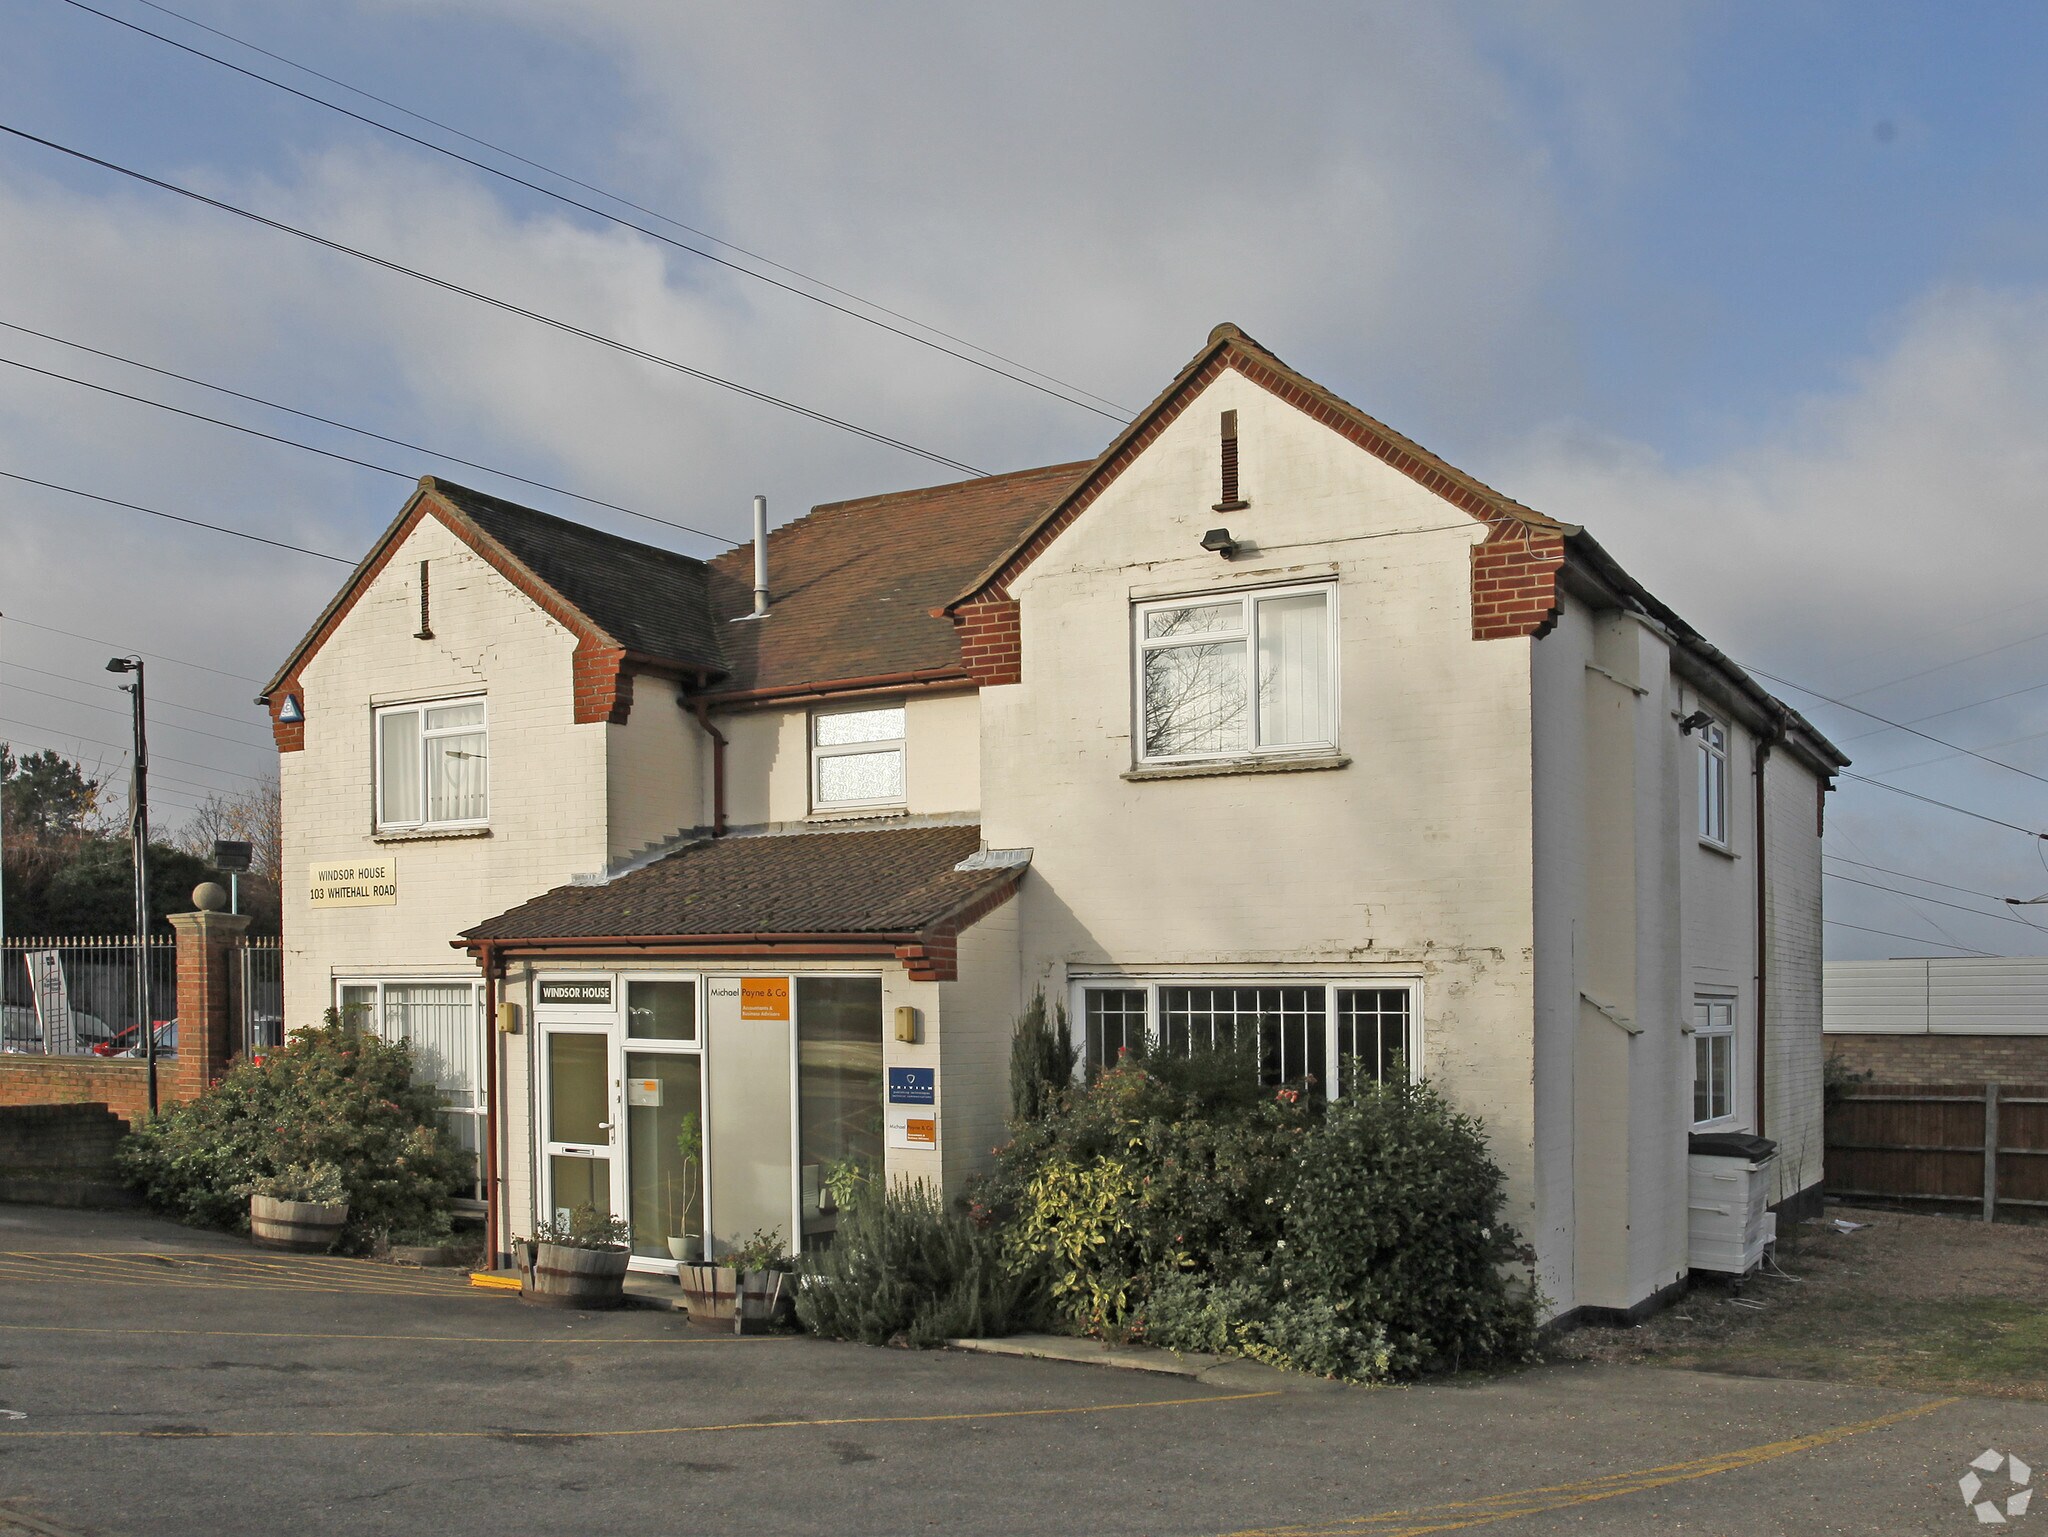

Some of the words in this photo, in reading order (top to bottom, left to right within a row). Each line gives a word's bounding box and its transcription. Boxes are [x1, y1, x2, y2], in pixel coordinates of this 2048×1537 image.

[318, 869, 355, 881] WINDSOR
[358, 867, 386, 879] HOUSE
[310, 888, 325, 900] 103
[328, 886, 370, 899] WHITEHALL
[373, 884, 396, 897] ROAD
[542, 987, 581, 998] WINDSOR
[582, 987, 610, 998] HOUSE
[710, 988, 740, 997] Michael
[741, 988, 765, 999] Payne
[766, 988, 773, 997] &
[775, 988, 787, 997] Co
